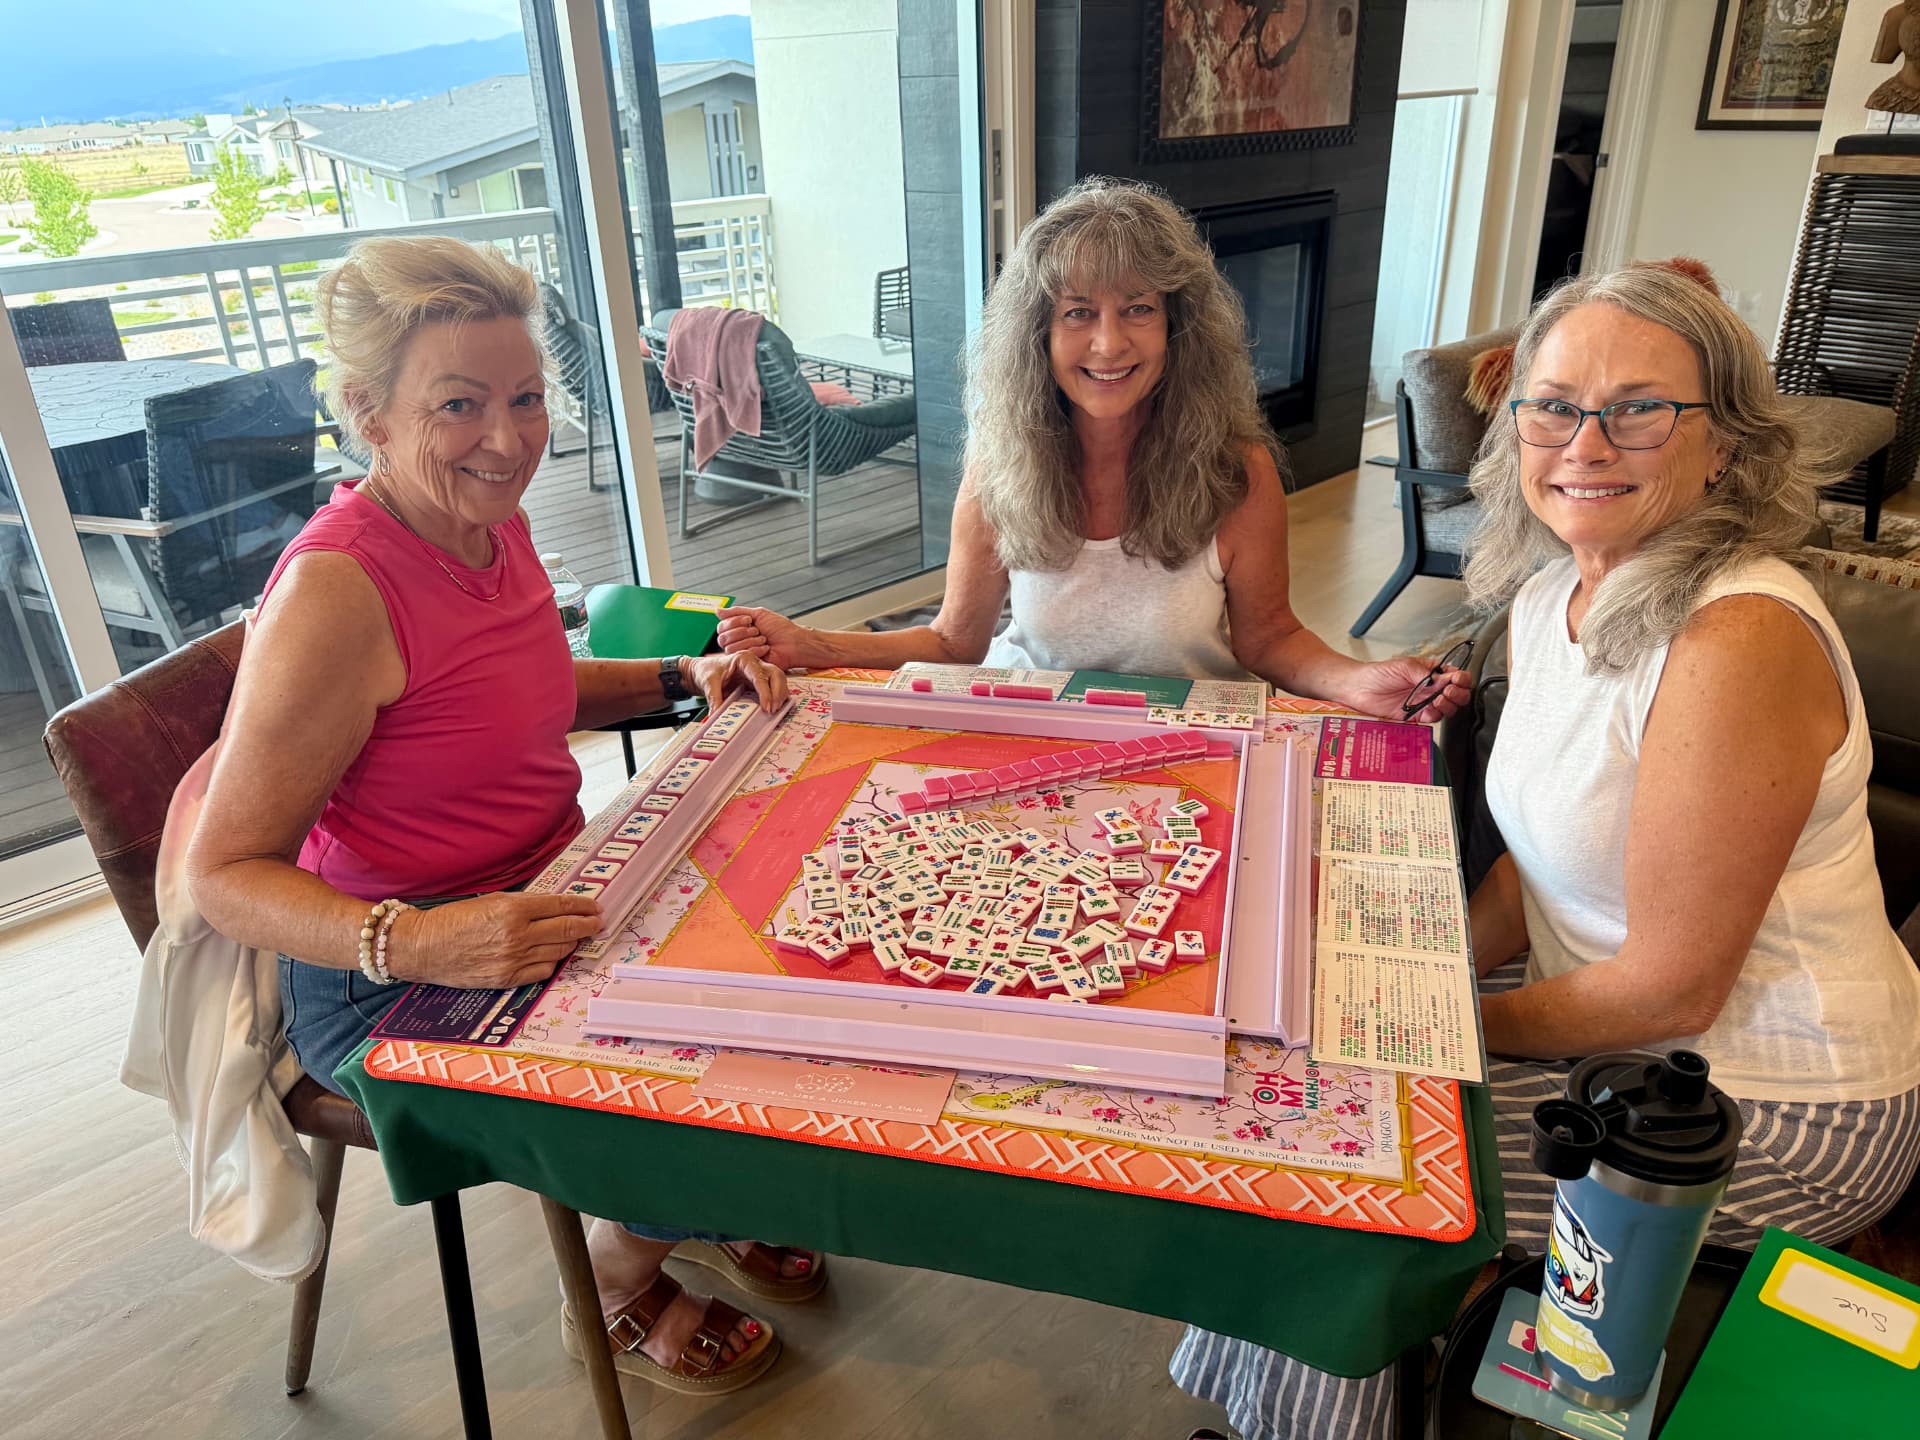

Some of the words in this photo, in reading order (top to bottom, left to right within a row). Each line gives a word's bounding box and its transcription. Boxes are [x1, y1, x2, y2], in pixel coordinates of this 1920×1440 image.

[942, 934, 955, 950] 中
[569, 1049, 589, 1058] RED
[590, 1053, 631, 1063] DRAGON
[634, 1059, 661, 1068] BAMS
[1253, 1071, 1280, 1105] OH
[1280, 1075, 1304, 1108] MY
[831, 1097, 867, 1106] JOKER
[898, 1105, 924, 1113] PAIR
[1095, 1125, 1137, 1138] JOKERS
[1140, 1133, 1163, 1143] MAY
[1165, 1137, 1189, 1146] NOT
[1193, 1141, 1208, 1149] BE
[1211, 1143, 1240, 1153] USED
[1243, 1149, 1256, 1157] IN
[1258, 1151, 1308, 1163] SINGLES
[1311, 1158, 1329, 1167] OR
[1331, 1160, 1365, 1170] PAIRS
[1379, 1110, 1393, 1153] DRAGONS
[1832, 1297, 1887, 1333] Sue
